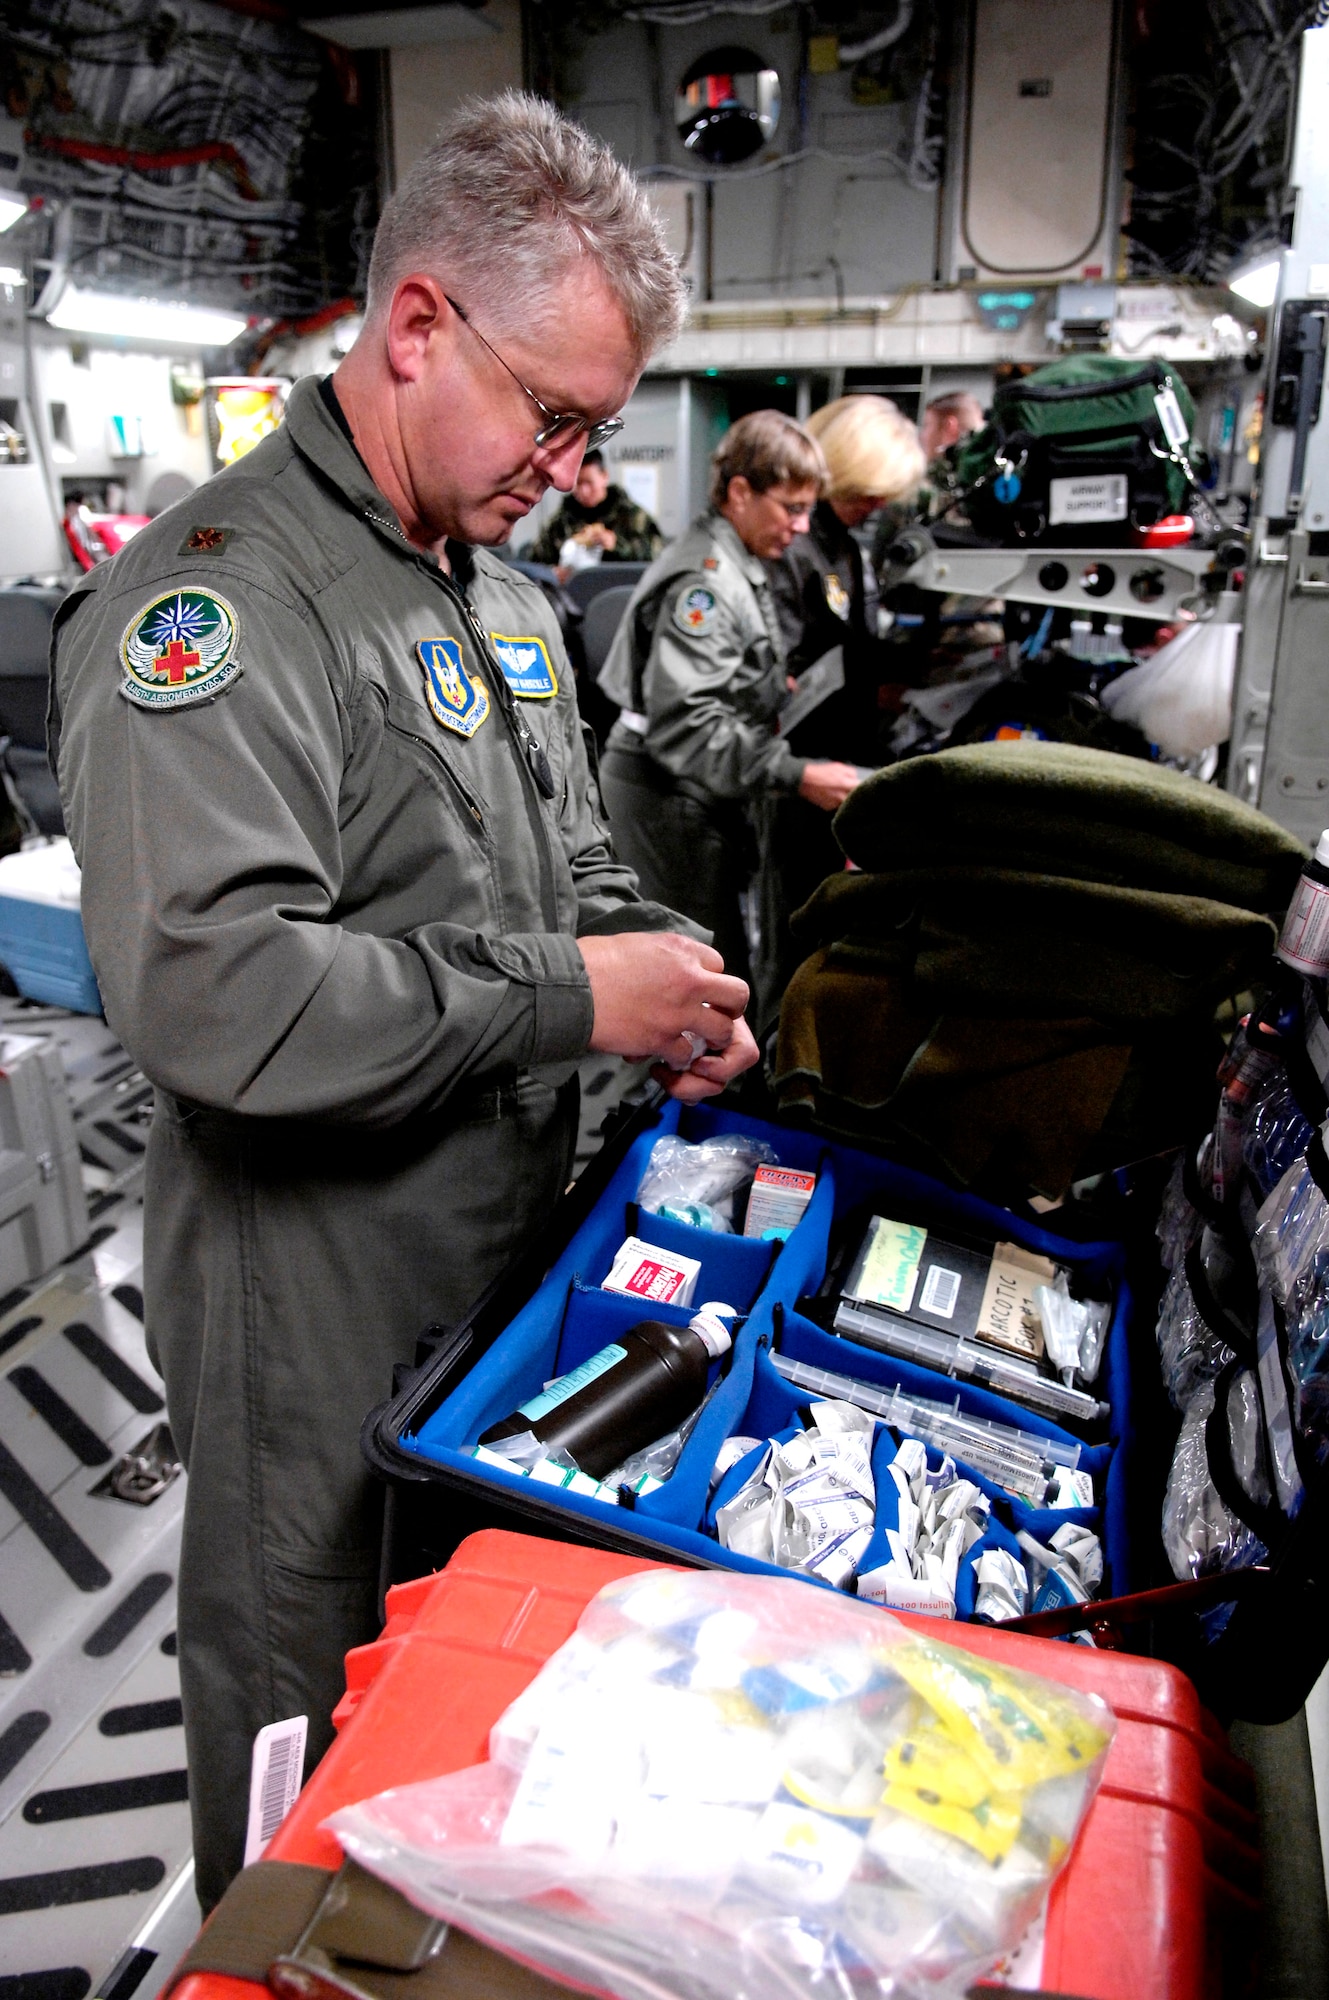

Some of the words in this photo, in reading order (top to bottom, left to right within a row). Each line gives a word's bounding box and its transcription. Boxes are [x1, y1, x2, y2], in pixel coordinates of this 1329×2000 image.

[1070, 484, 1105, 496] AIRWAY
[1066, 501, 1109, 511] SUPPORT
[895, 1225, 924, 1261] Only
[645, 1266, 678, 1300] TYLENOL
[878, 1259, 917, 1304] Training
[989, 1276, 1017, 1340] NARCOTIC
[1015, 1322, 1037, 1351] BOX
[961, 1450, 974, 1459] USP
[1000, 1464, 1037, 1482] FUROSEMIDE
[919, 1600, 950, 1609] Insulin
